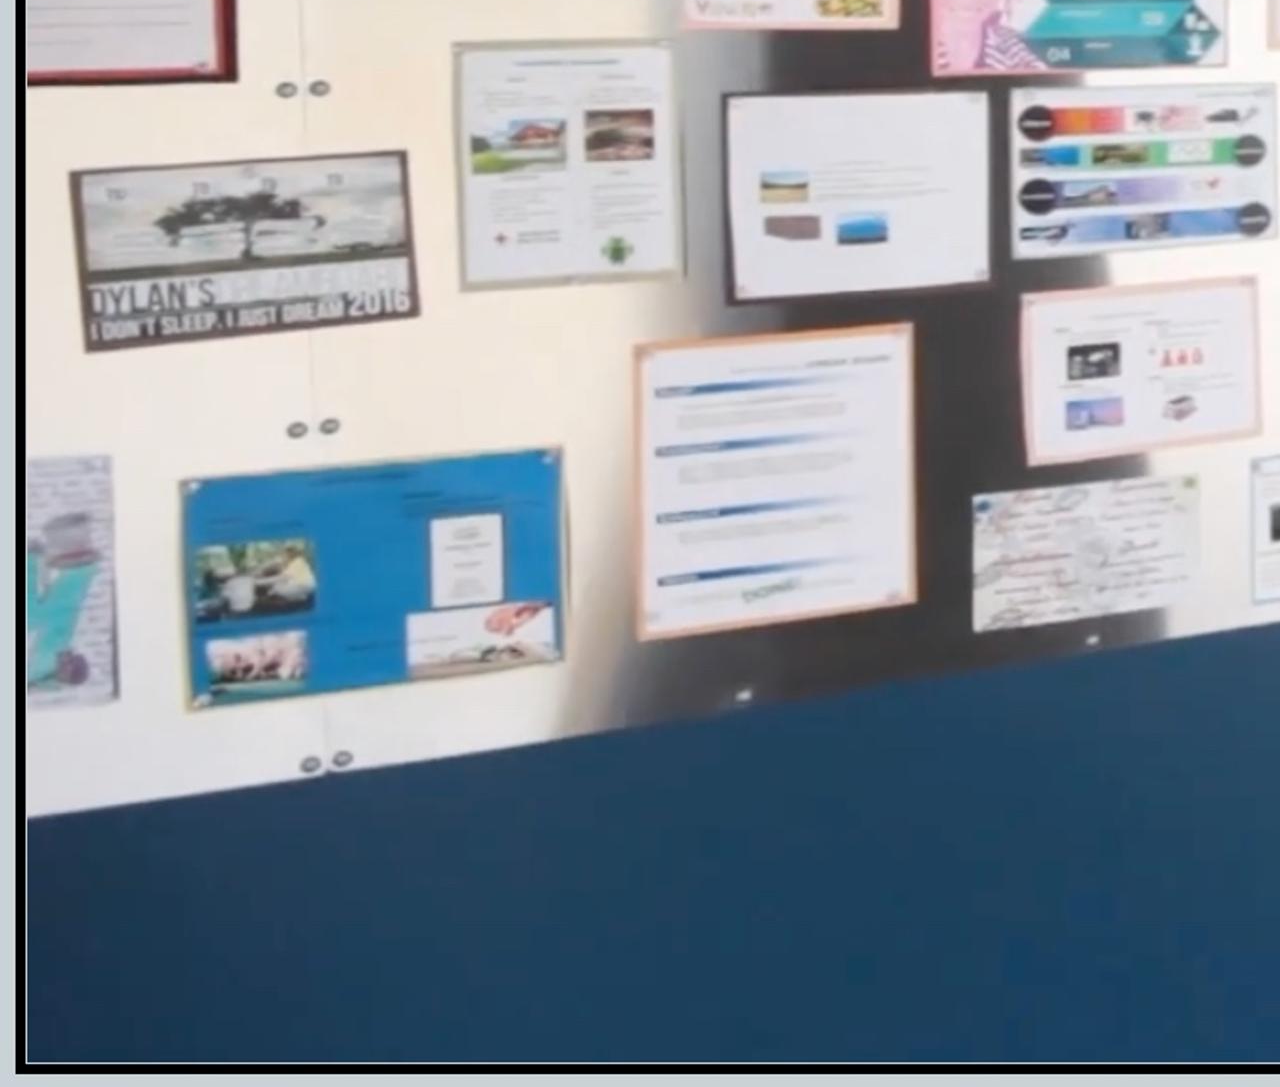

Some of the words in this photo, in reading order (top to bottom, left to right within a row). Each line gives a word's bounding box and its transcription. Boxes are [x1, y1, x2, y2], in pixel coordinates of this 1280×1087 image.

[89, 278, 216, 314] DYLAN'S
[101, 315, 158, 341] DON'T
[161, 310, 223, 335] SLEEP.
[236, 304, 278, 328] JUST
[281, 298, 345, 323] DREAM
[349, 288, 411, 317] 2016
